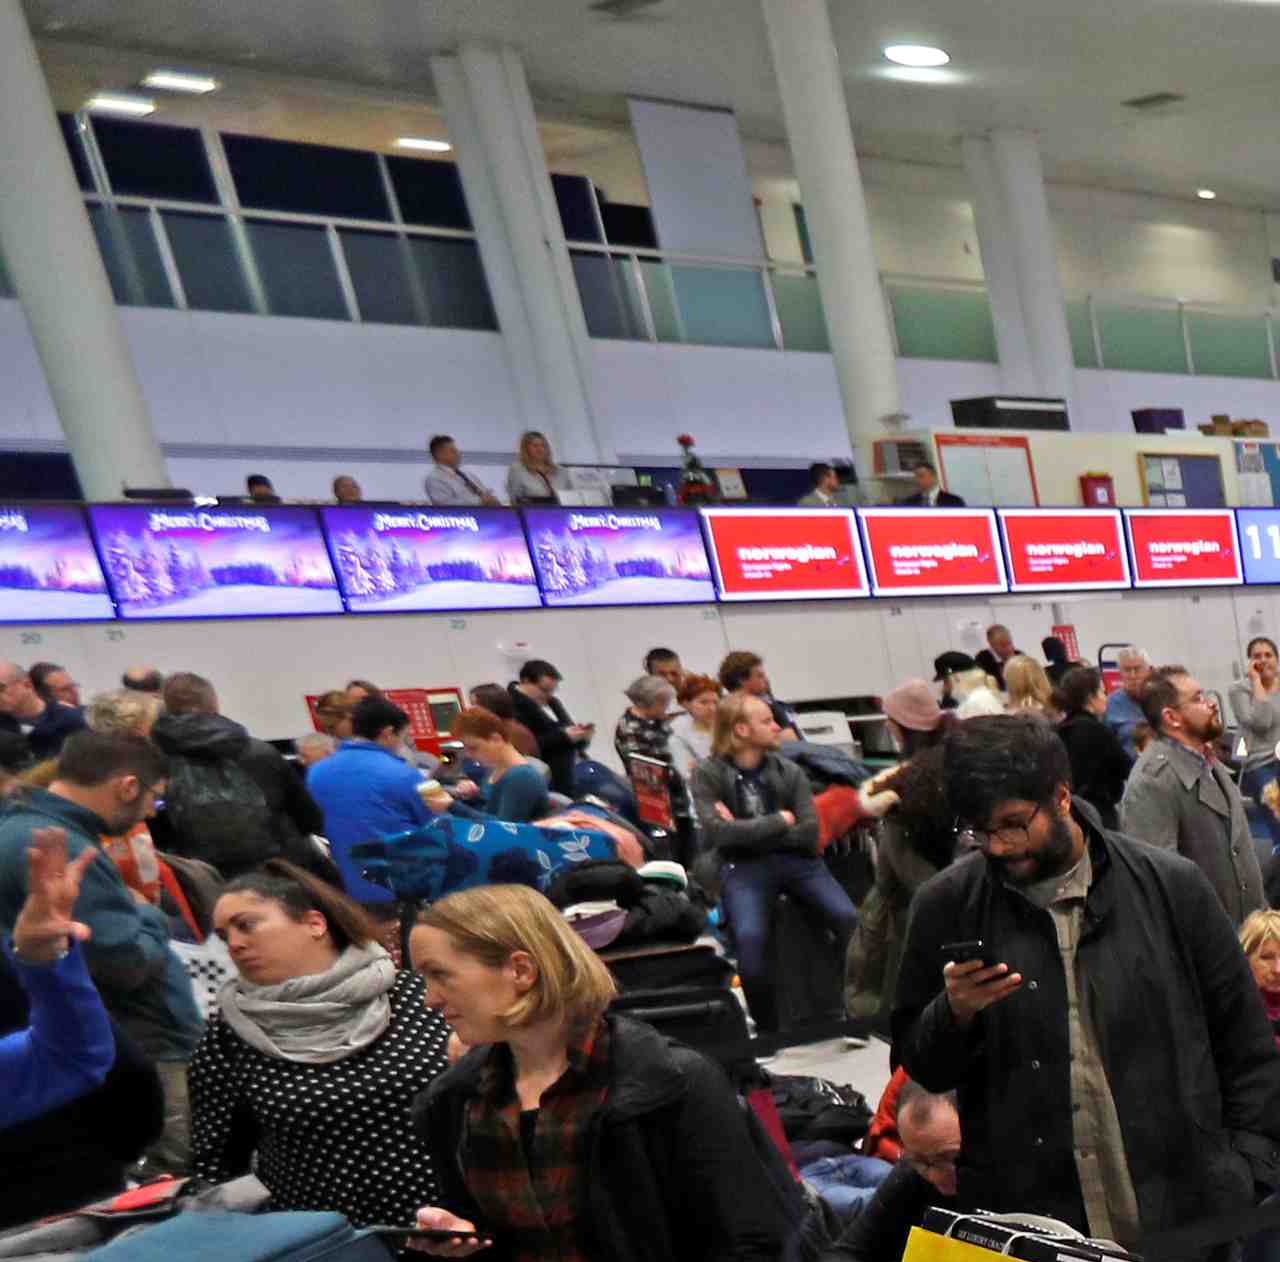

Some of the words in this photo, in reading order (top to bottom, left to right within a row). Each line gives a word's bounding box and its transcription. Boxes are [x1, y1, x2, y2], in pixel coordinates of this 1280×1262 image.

[198, 513, 272, 532] CHRISTMAS
[418, 515, 480, 531] CHRISTMAS
[608, 515, 662, 530] CHRISTMAS
[736, 544, 837, 562] norwegian
[889, 542, 978, 560] norwegian
[1026, 540, 1105, 558] norwegian
[1148, 539, 1221, 556] norwegian
